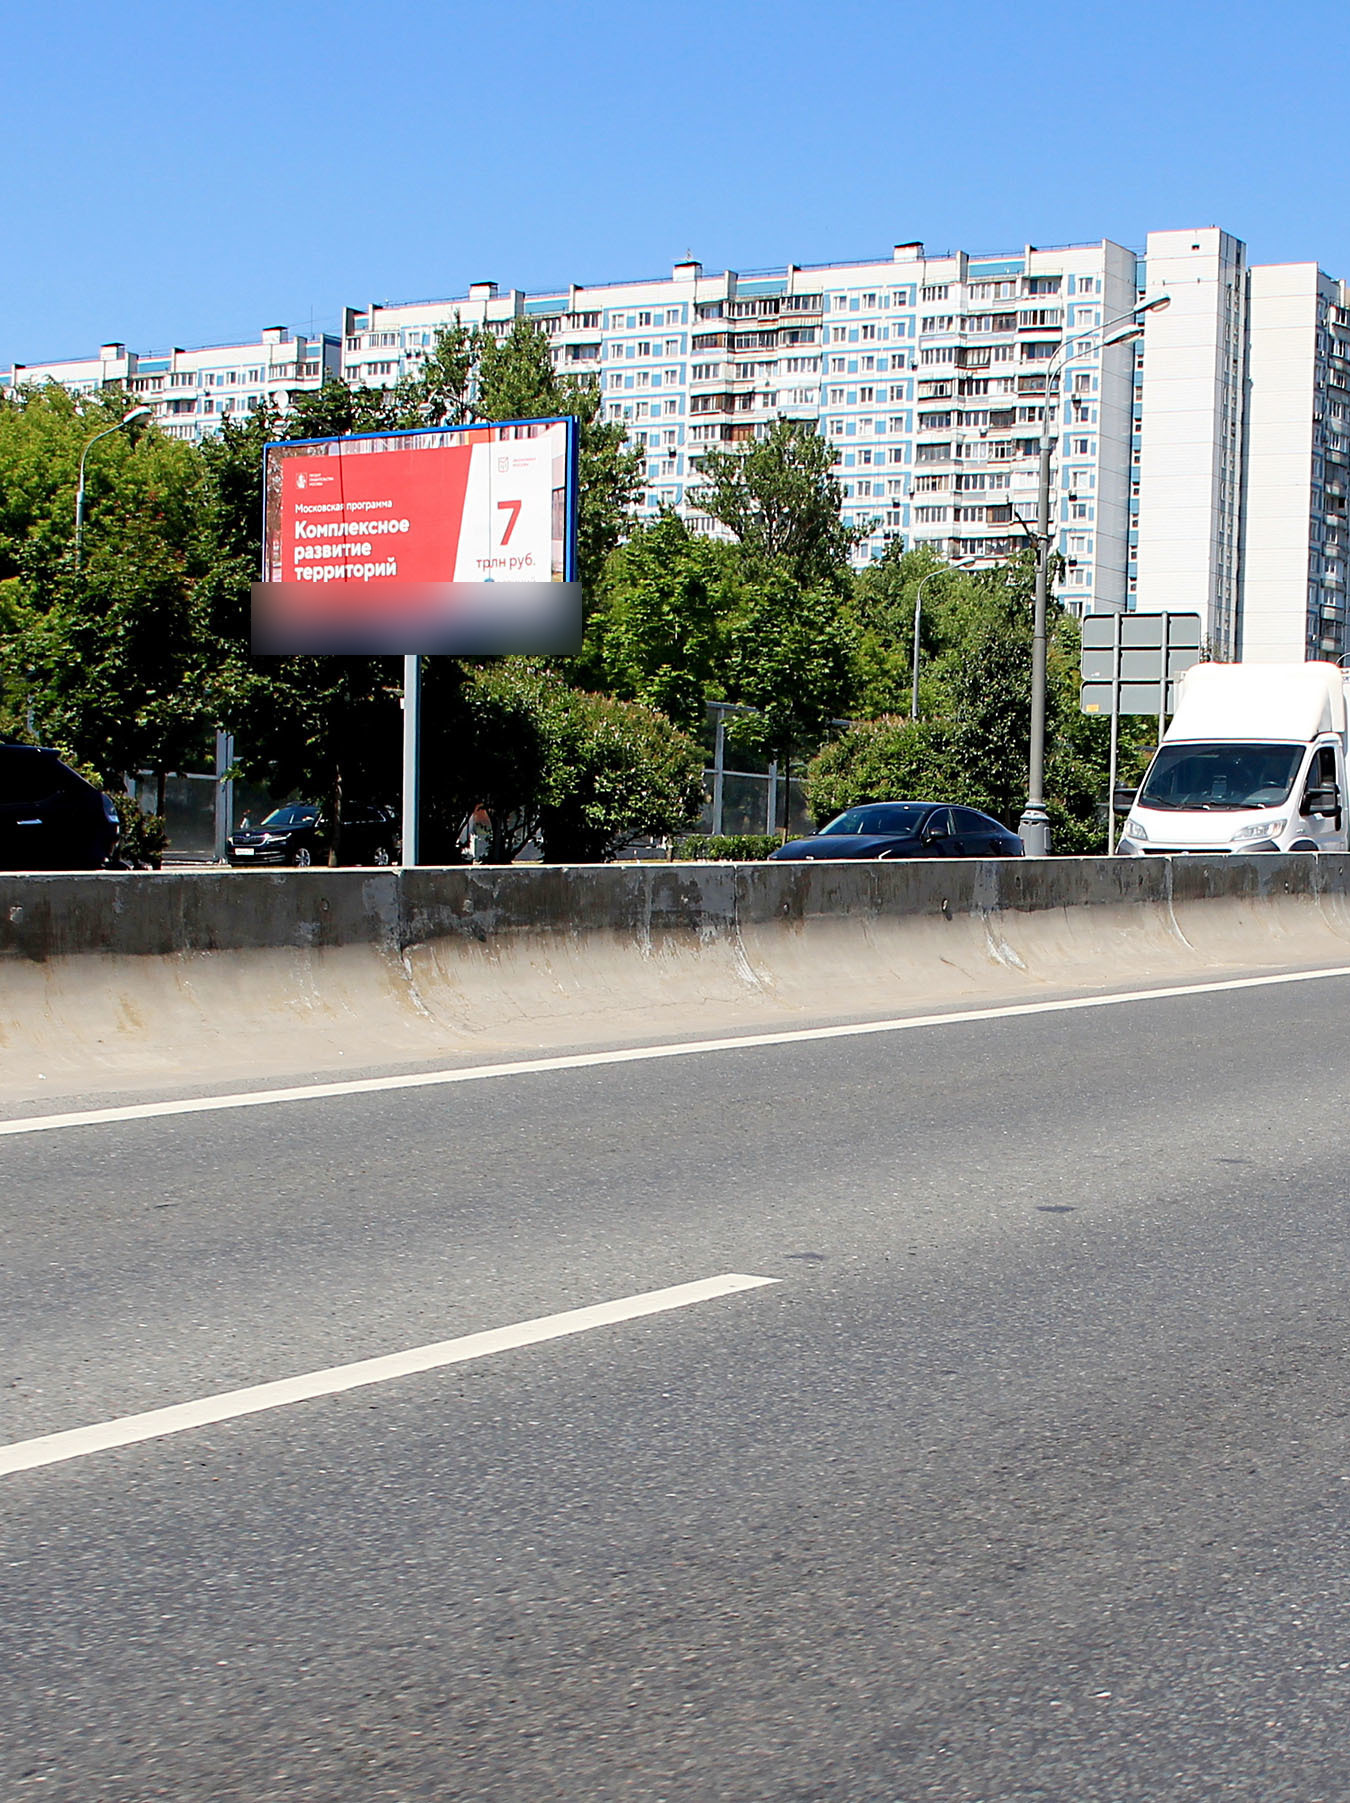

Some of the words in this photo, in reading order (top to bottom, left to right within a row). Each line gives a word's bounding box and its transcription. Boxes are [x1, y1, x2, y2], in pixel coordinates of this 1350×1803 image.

[295, 503, 344, 514] Московская
[346, 500, 393, 513] программа
[294, 518, 410, 540] Комплексное
[497, 500, 522, 546] 7
[294, 541, 372, 564] развитие
[476, 558, 506, 572] трлн
[509, 552, 536, 570] руб.
[294, 556, 397, 583] территорий
